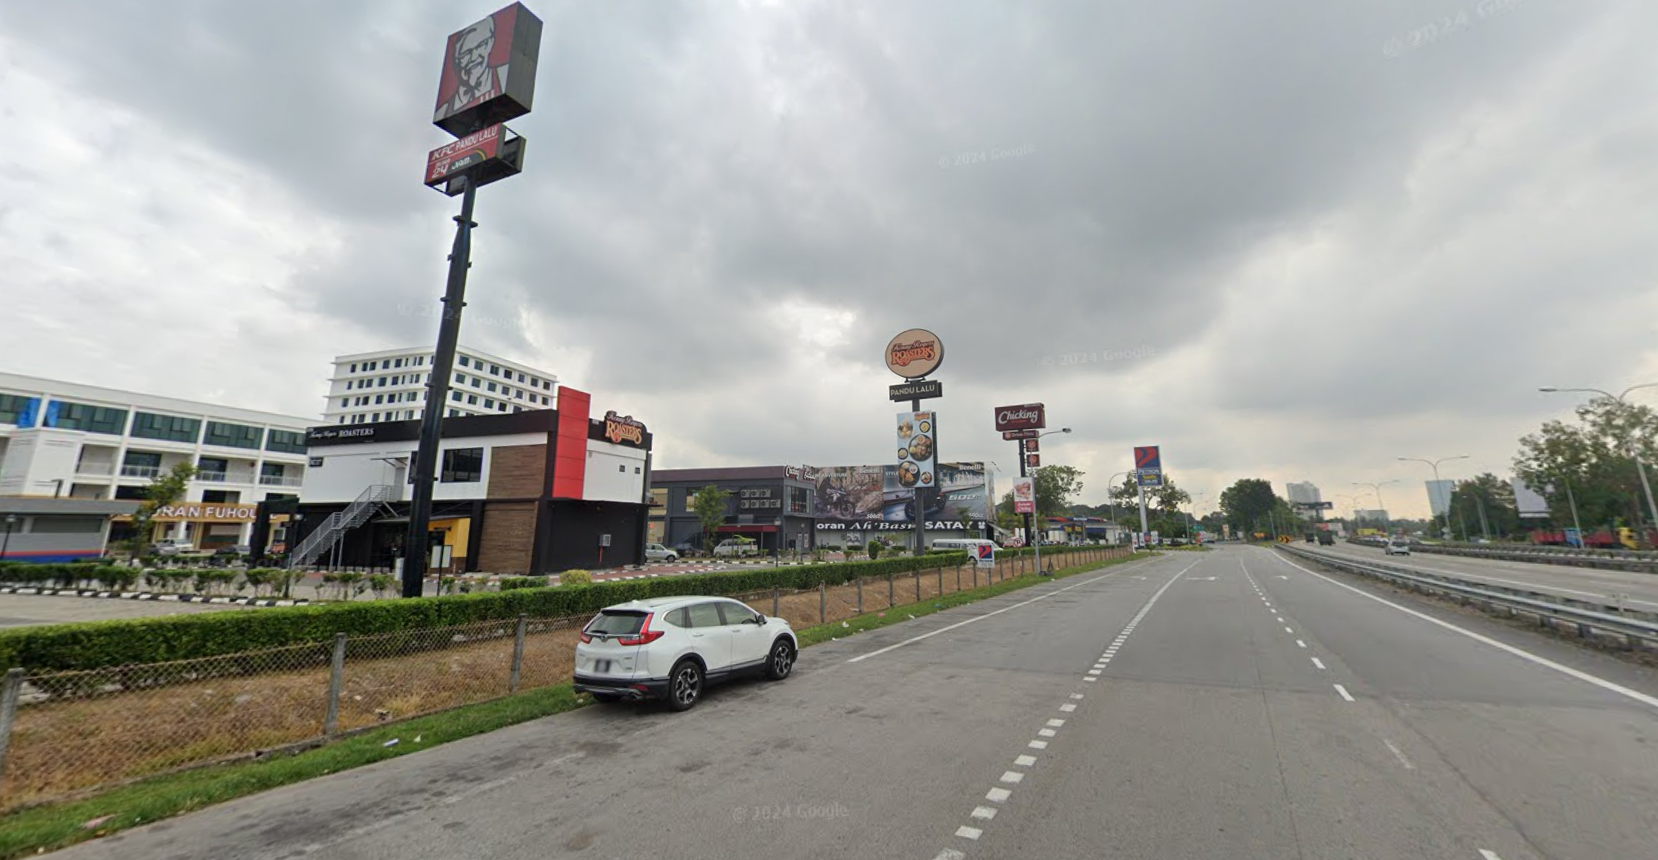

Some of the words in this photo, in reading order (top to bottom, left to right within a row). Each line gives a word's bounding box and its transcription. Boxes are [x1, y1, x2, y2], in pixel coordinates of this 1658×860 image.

[432, 143, 455, 160] KFC
[455, 134, 479, 151] PANDU
[478, 125, 498, 142] LALU
[432, 163, 449, 179] 24
[891, 346, 936, 366] ROASTERS
[890, 386, 915, 396] PANDU
[915, 384, 935, 393] LALU
[998, 409, 1039, 424] Chicking
[338, 427, 375, 438] ROASTERS
[605, 420, 642, 445] ROASTERS
[925, 520, 974, 530] SATAY
